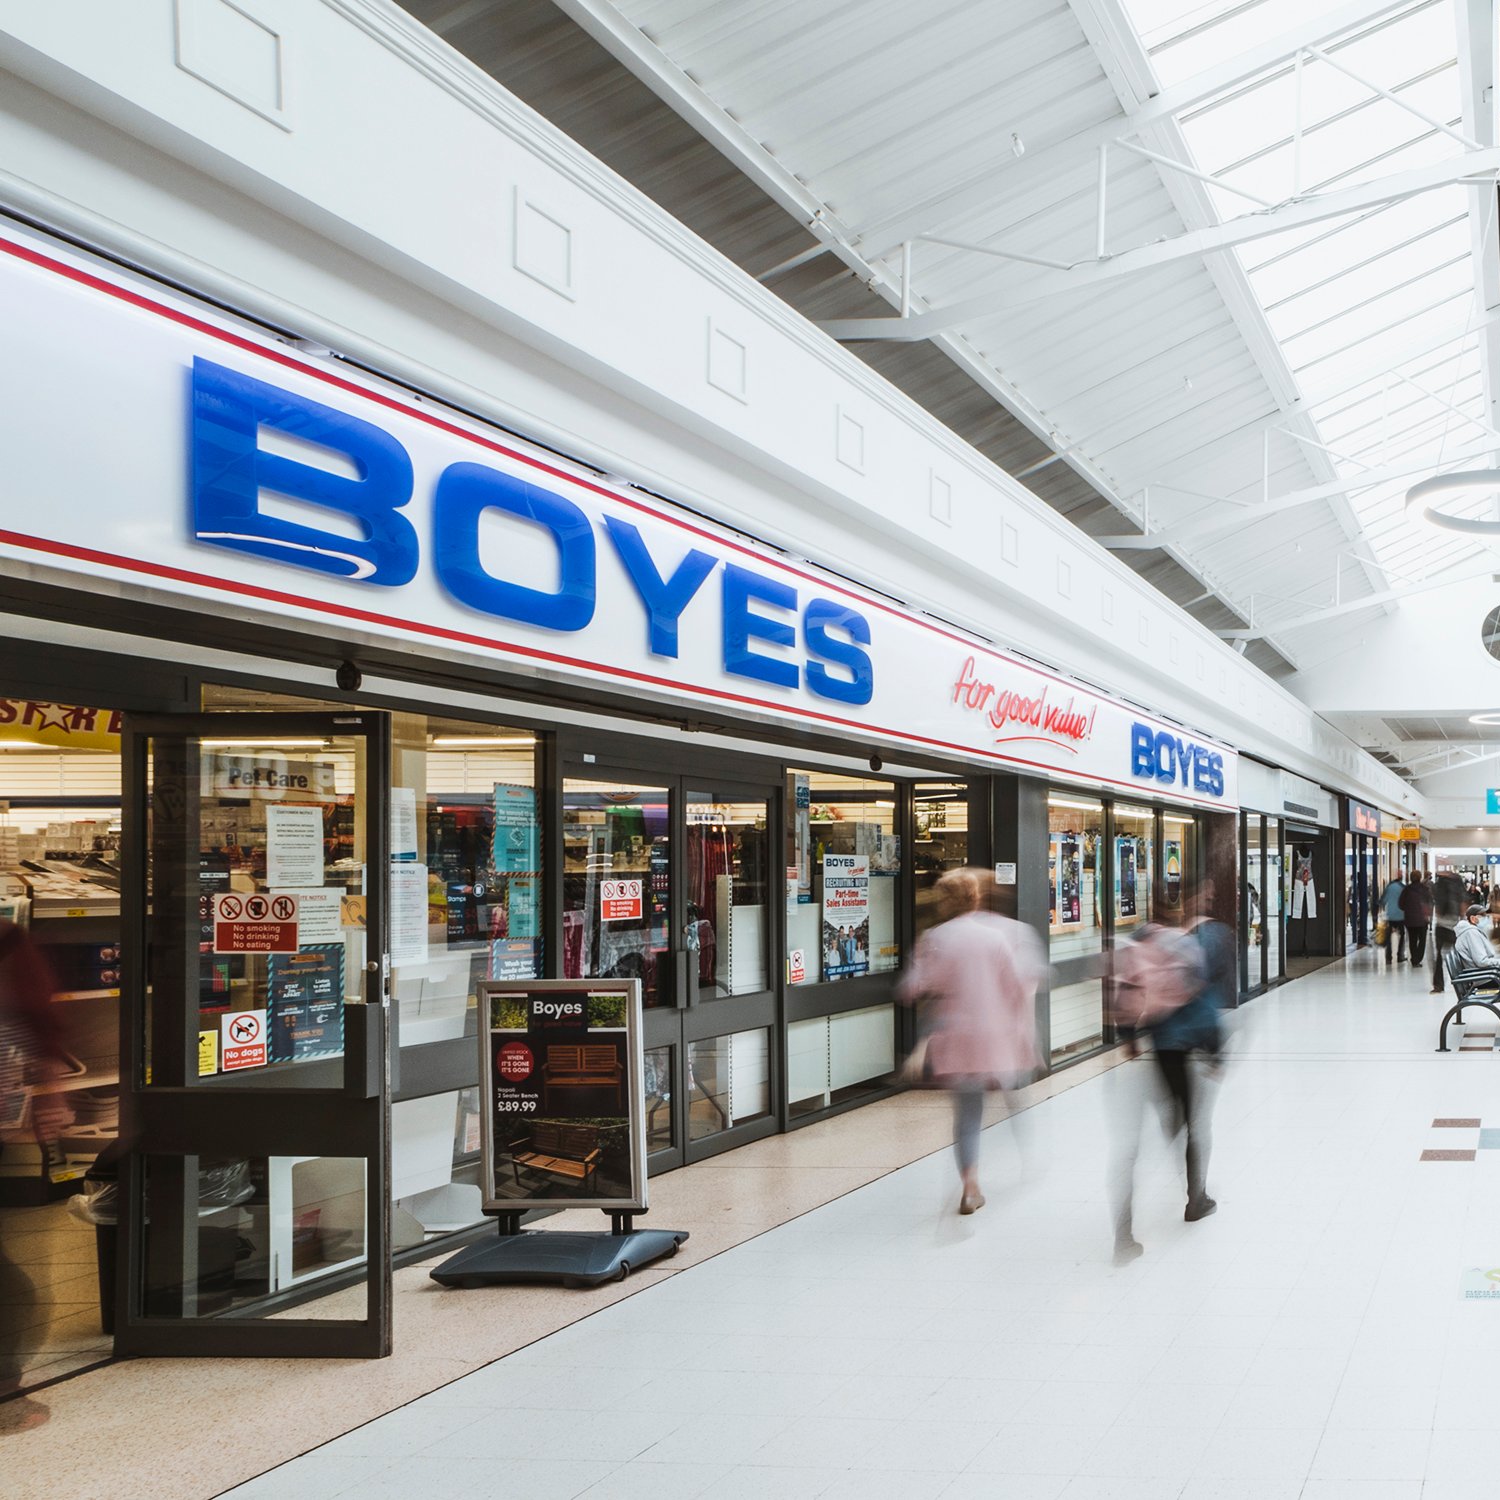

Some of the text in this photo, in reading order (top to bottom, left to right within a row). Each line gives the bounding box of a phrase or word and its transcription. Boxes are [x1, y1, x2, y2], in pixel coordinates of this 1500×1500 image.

[191, 354, 874, 706] BOYES
[953, 656, 995, 710] for
[988, 685, 1048, 729] good
[1131, 721, 1224, 798] BOYES
[229, 767, 309, 789] Pet Care
[826, 858, 855, 867] BOYES
[826, 878, 855, 888] RECRUITING
[835, 889, 859, 898] Part-time
[826, 898, 867, 908] Sales Assistants
[233, 924, 281, 934] No smoking
[233, 932, 280, 942] No drinking
[233, 940, 271, 950] No eating
[533, 1001, 583, 1019] Boyes
[226, 1047, 263, 1059] No dogs
[497, 1101, 537, 1112] £89.99
